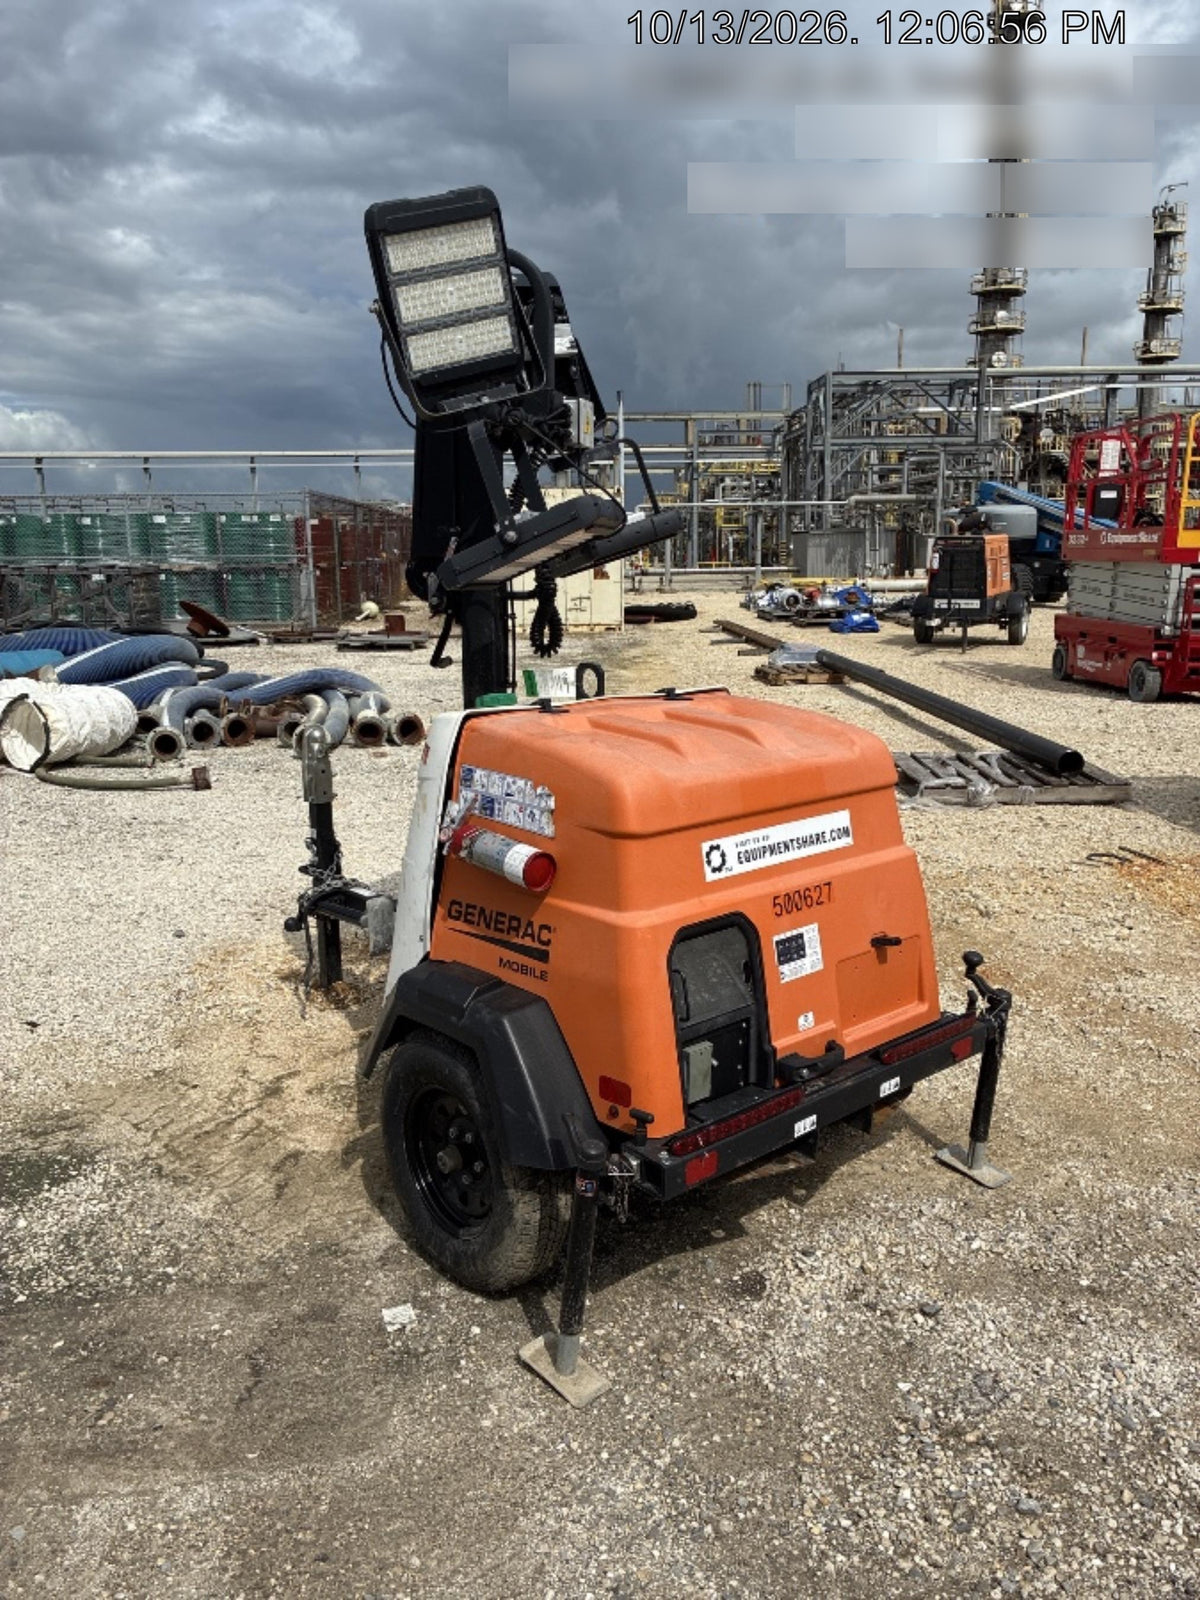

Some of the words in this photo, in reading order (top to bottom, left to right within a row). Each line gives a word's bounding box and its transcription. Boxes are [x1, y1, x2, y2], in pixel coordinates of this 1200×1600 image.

[737, 825, 851, 865] EQUIPMENTSHARE.COM
[772, 881, 832, 917] 500627
[447, 899, 552, 947] GENERAC
[498, 955, 549, 982] MOBILE
